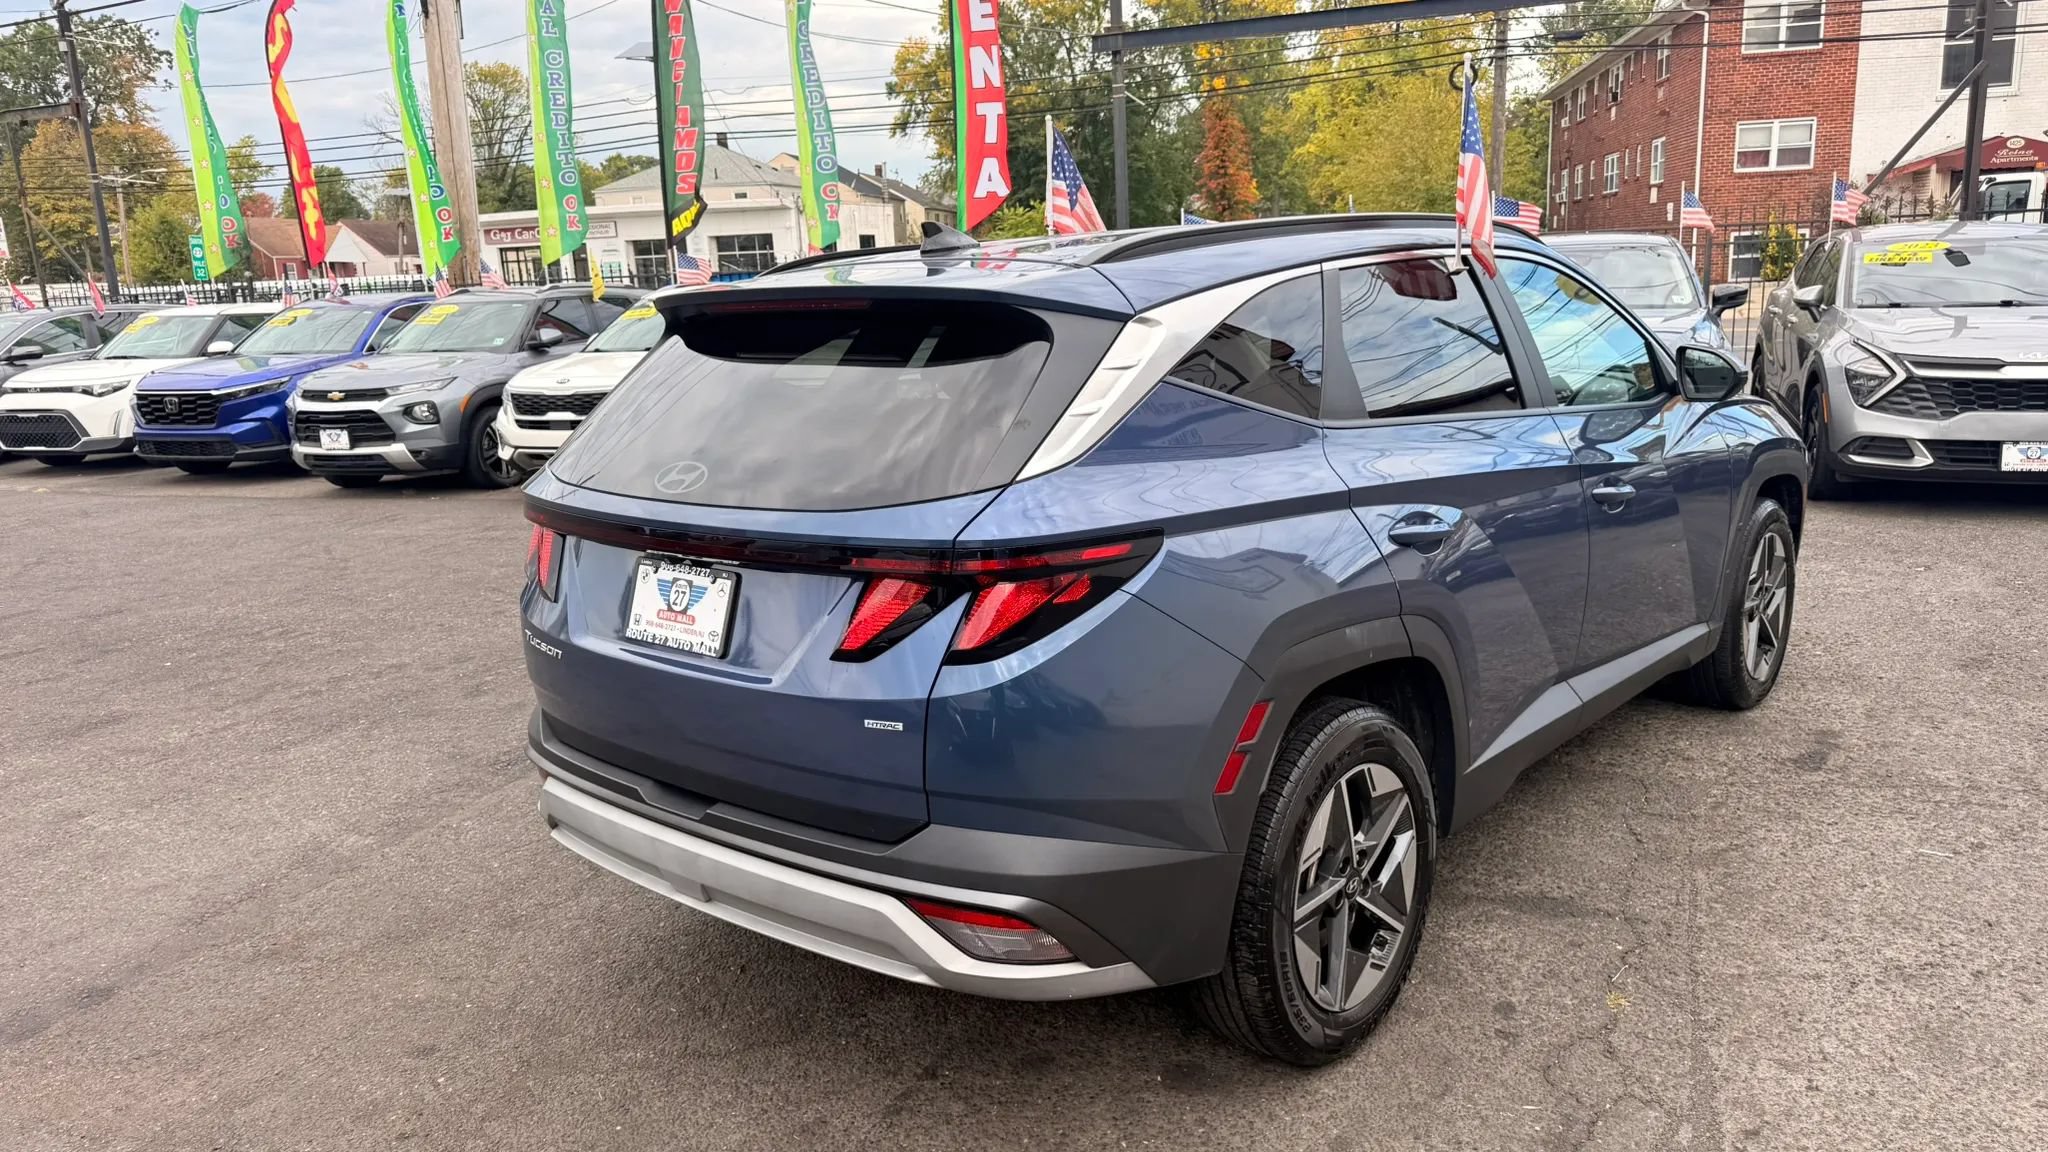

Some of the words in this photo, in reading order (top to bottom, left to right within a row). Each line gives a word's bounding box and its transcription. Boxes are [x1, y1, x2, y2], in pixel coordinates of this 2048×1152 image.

[797, 20, 839, 174] CREDITO
[544, 50, 578, 187] CREDITO
[562, 194, 582, 231] OK
[1990, 156, 2039, 164] Apartments
[196, 268, 206, 277] 32
[660, 561, 711, 577] 908-648-2727
[672, 589, 686, 607] 27
[659, 610, 675, 620] AUTO
[677, 613, 693, 623] MALL
[625, 628, 654, 640] ROUTE
[656, 634, 666, 645] 27
[667, 638, 690, 650] AUTO
[691, 642, 717, 657] MALL
[866, 721, 901, 730] HTRAC
